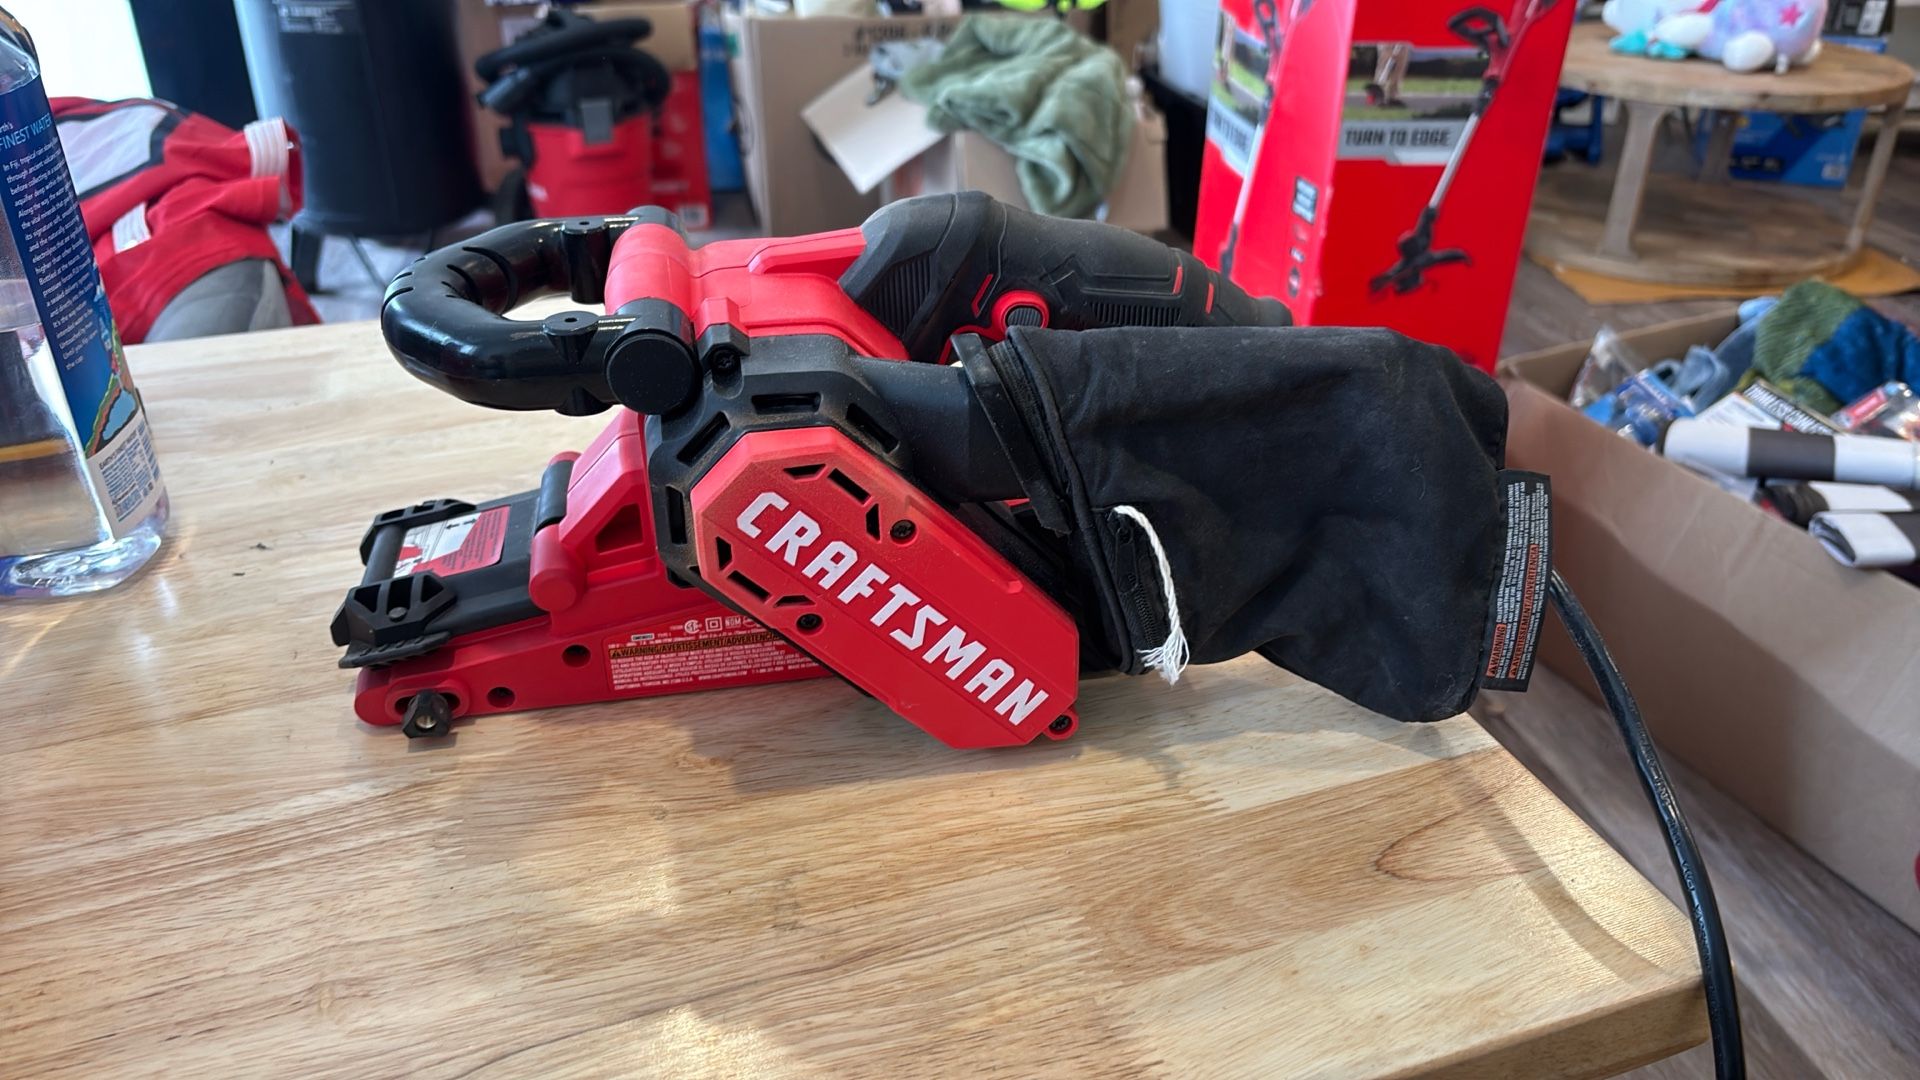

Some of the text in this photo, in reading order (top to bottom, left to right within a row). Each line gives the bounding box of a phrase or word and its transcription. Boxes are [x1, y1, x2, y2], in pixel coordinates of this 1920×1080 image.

[1346, 127, 1451, 147] TURN TO EDGE
[736, 491, 1050, 726] CRAFTSMAN
[1491, 626, 1505, 665] WARNING
[1512, 546, 1537, 666] AVERTISSEMENT/ADVERTENCIA
